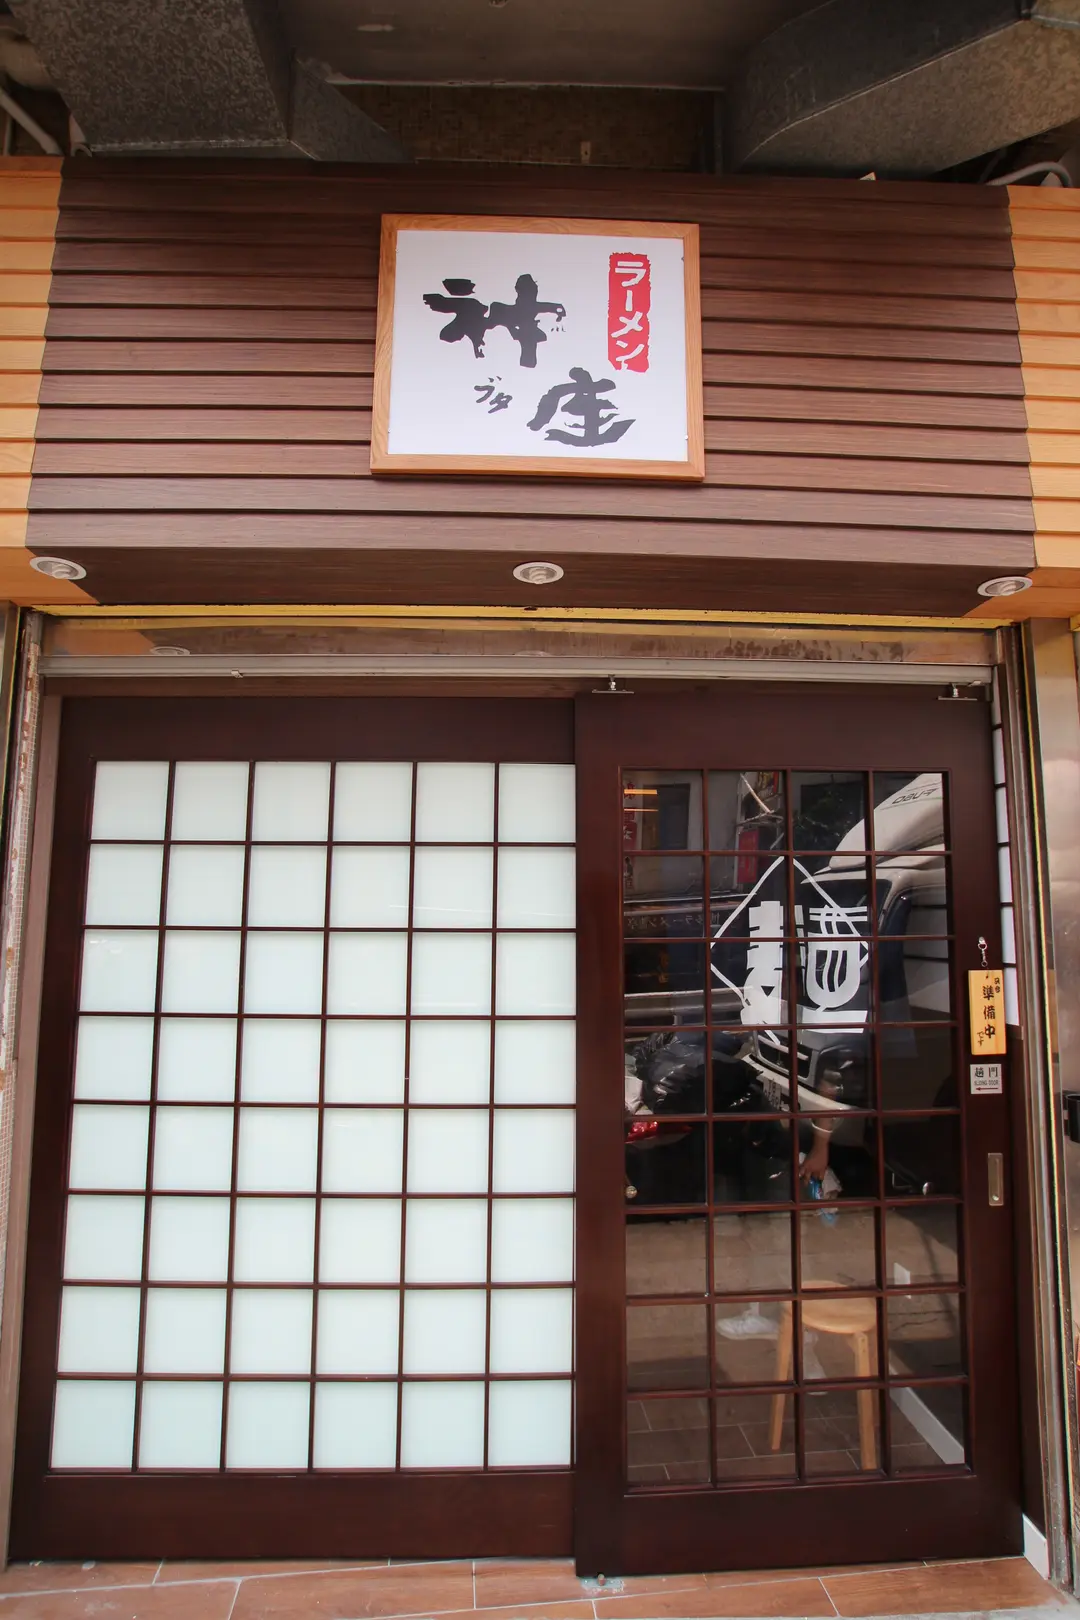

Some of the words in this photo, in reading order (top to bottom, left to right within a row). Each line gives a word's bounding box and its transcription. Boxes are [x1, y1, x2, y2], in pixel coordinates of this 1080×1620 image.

[611, 261, 647, 371] ラーメン
[474, 376, 513, 414] ブタ
[983, 985, 996, 1039] 準備中
